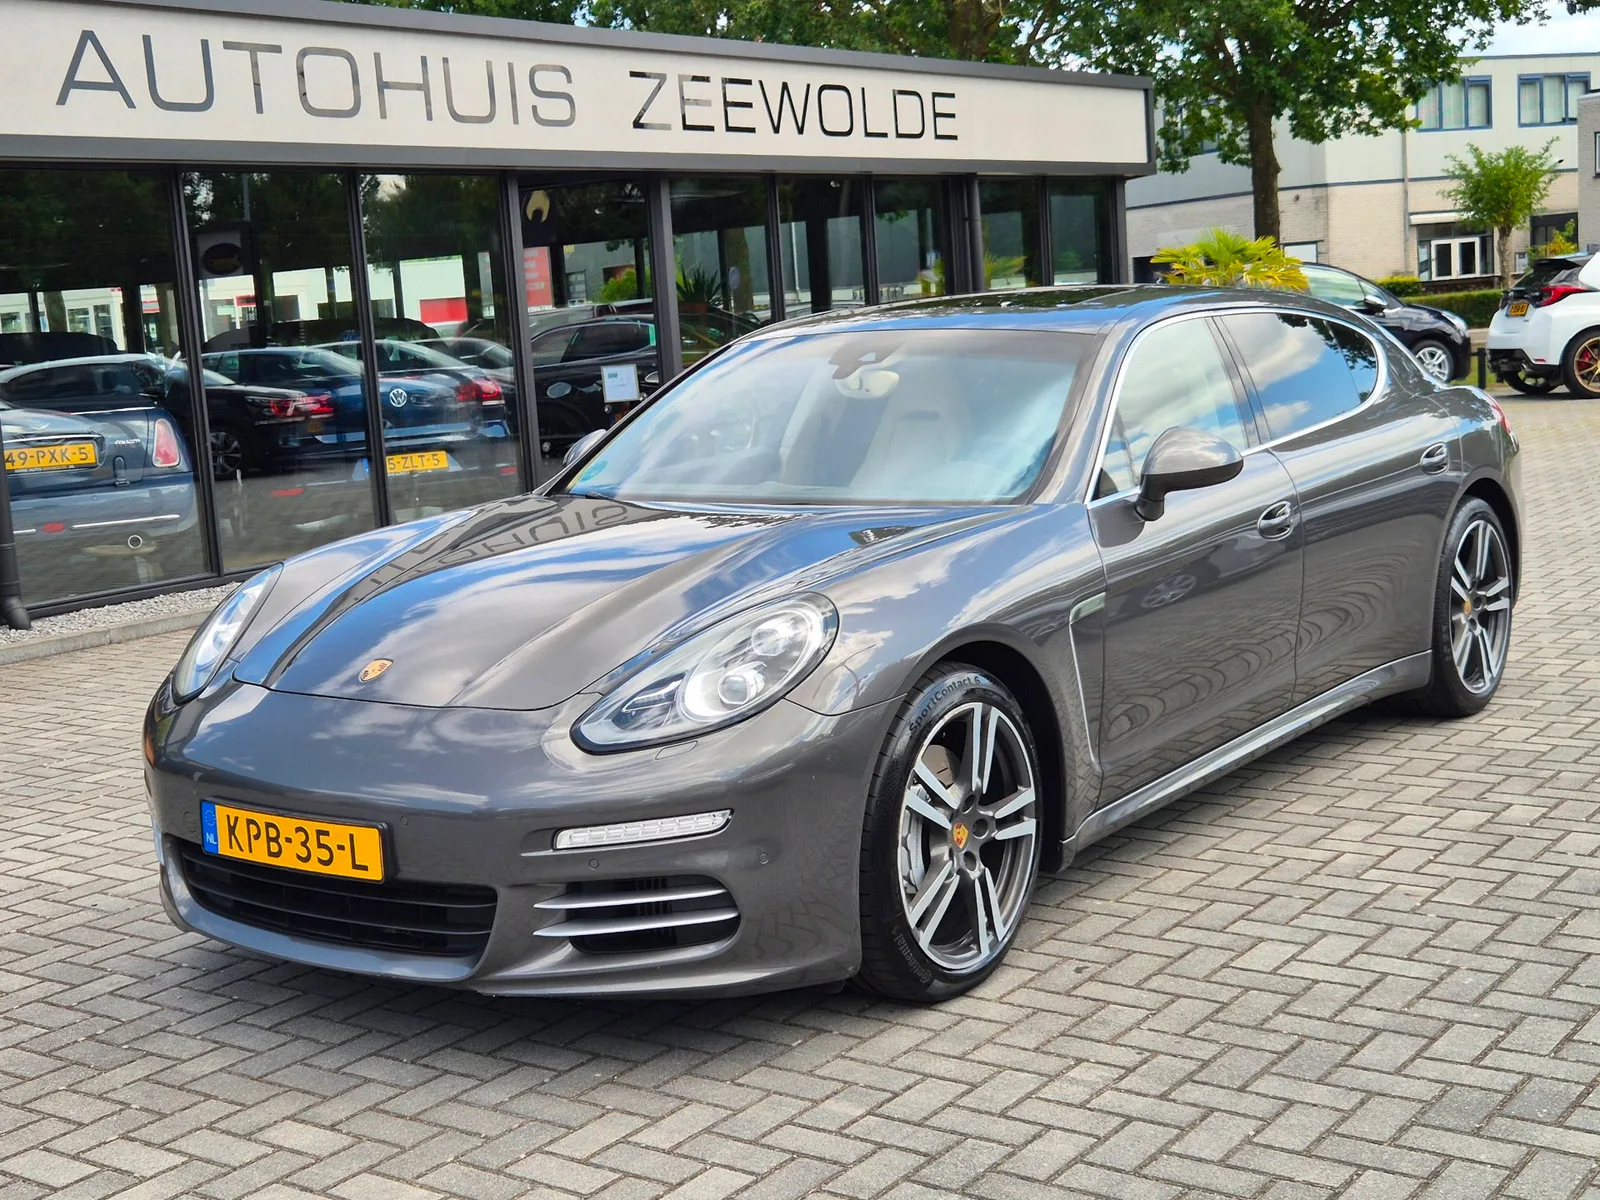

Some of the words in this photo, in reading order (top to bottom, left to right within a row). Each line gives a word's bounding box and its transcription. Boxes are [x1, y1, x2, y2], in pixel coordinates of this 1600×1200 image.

[56, 30, 576, 127] AUTOHUIS
[629, 71, 958, 141] ZEEWOLDE
[6, 447, 89, 467] 49-PXK-5
[387, 453, 440, 471] 5-ZLT-5
[908, 676, 972, 736] SportContact
[973, 675, 981, 685] 6
[205, 832, 218, 845] NL
[226, 814, 369, 872] KPB-35-L
[894, 932, 932, 983] Continental
